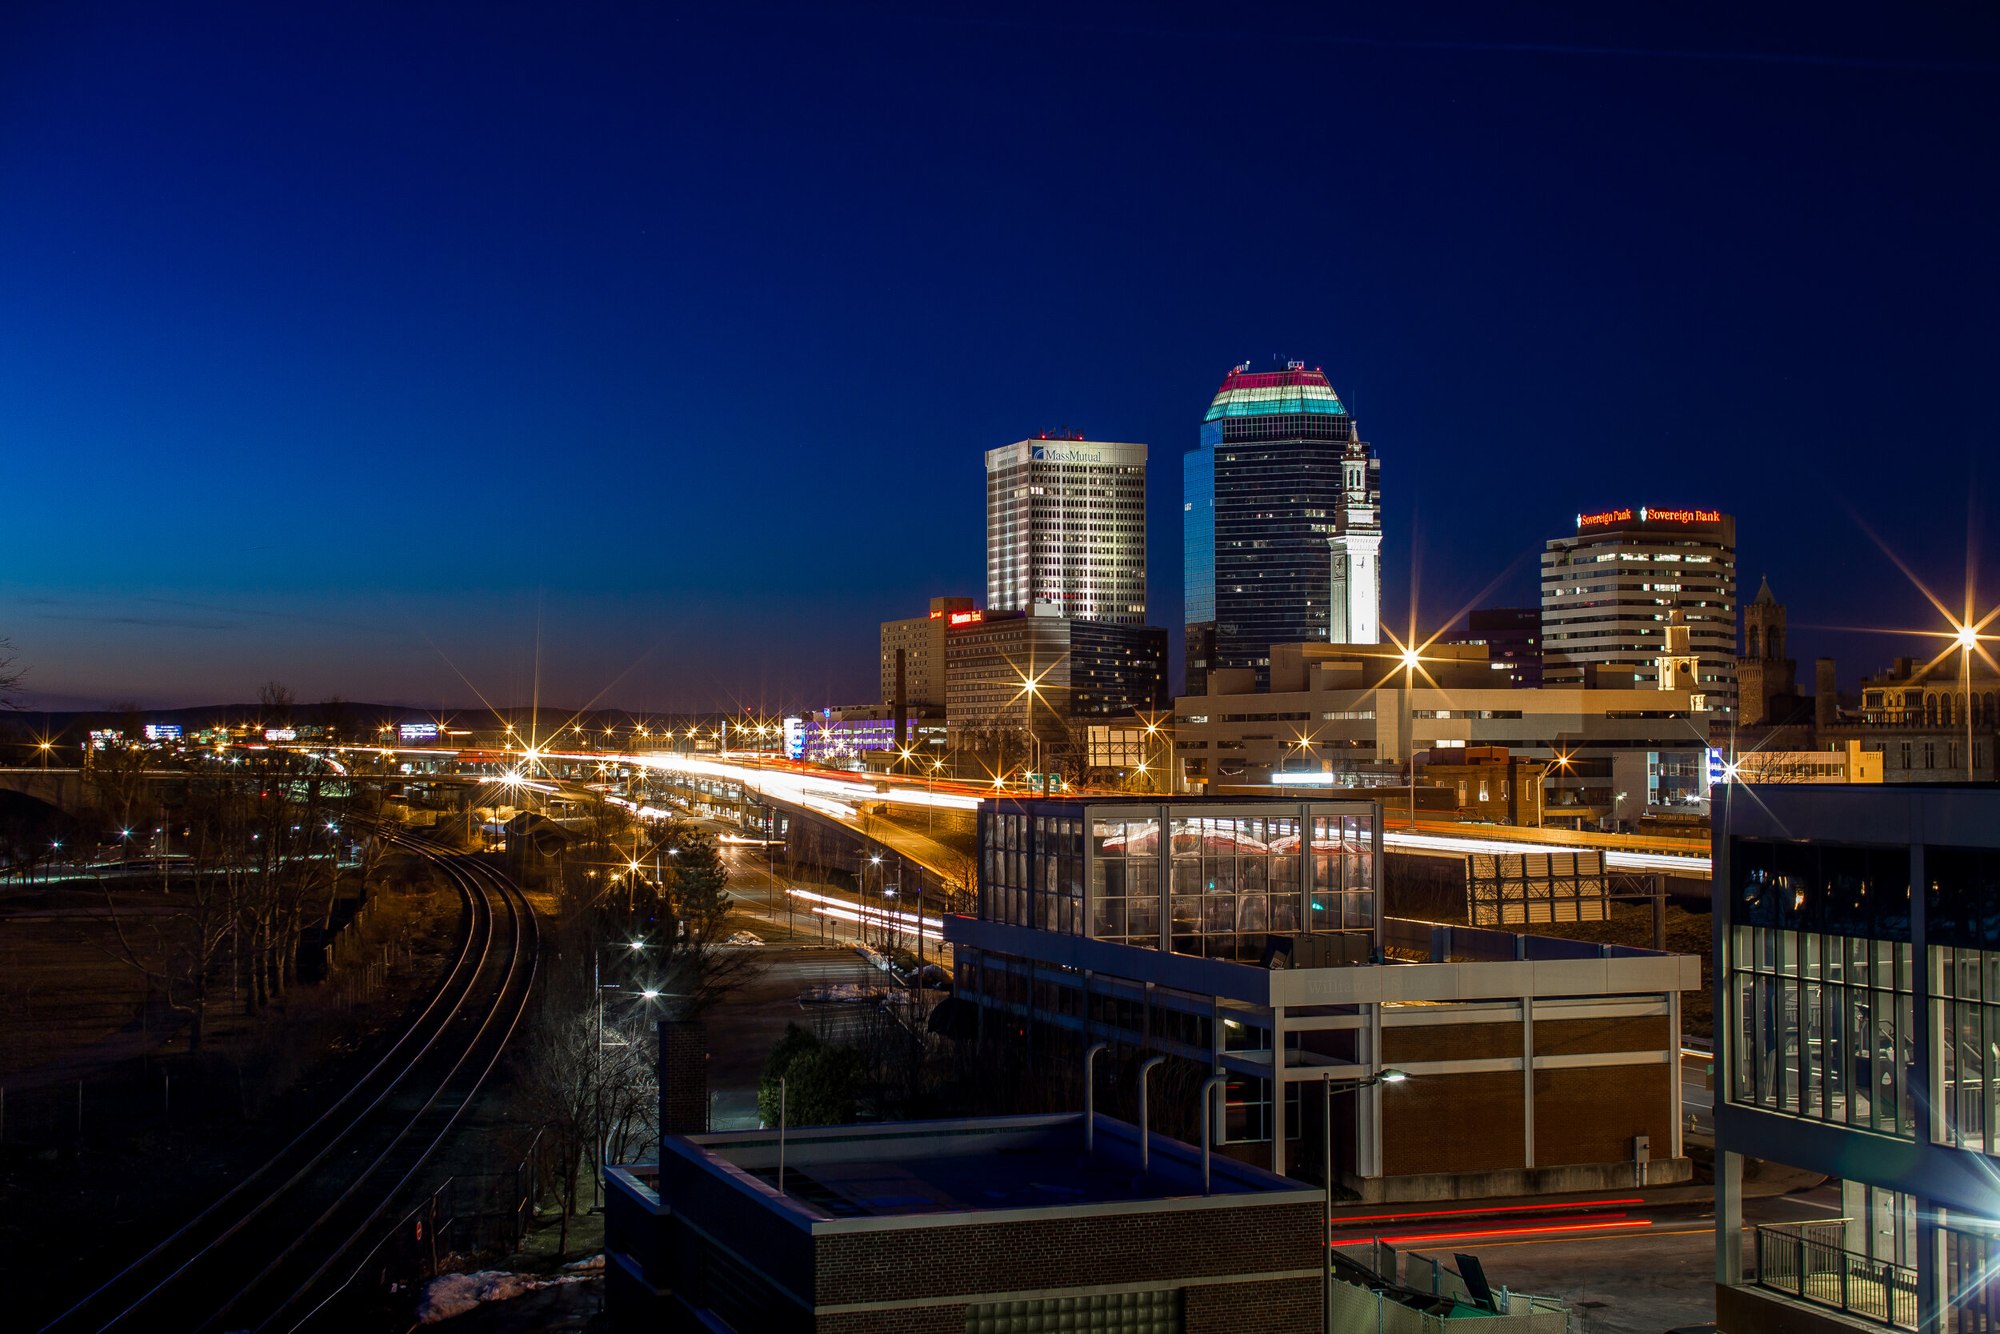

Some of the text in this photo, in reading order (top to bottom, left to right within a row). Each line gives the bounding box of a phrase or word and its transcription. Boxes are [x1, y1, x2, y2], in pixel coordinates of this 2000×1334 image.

[1046, 450, 1101, 462] MassMutual
[1581, 512, 1613, 525] Sovereign
[1648, 509, 1720, 523] Sovereign Bank
[1308, 978, 1365, 994] William
